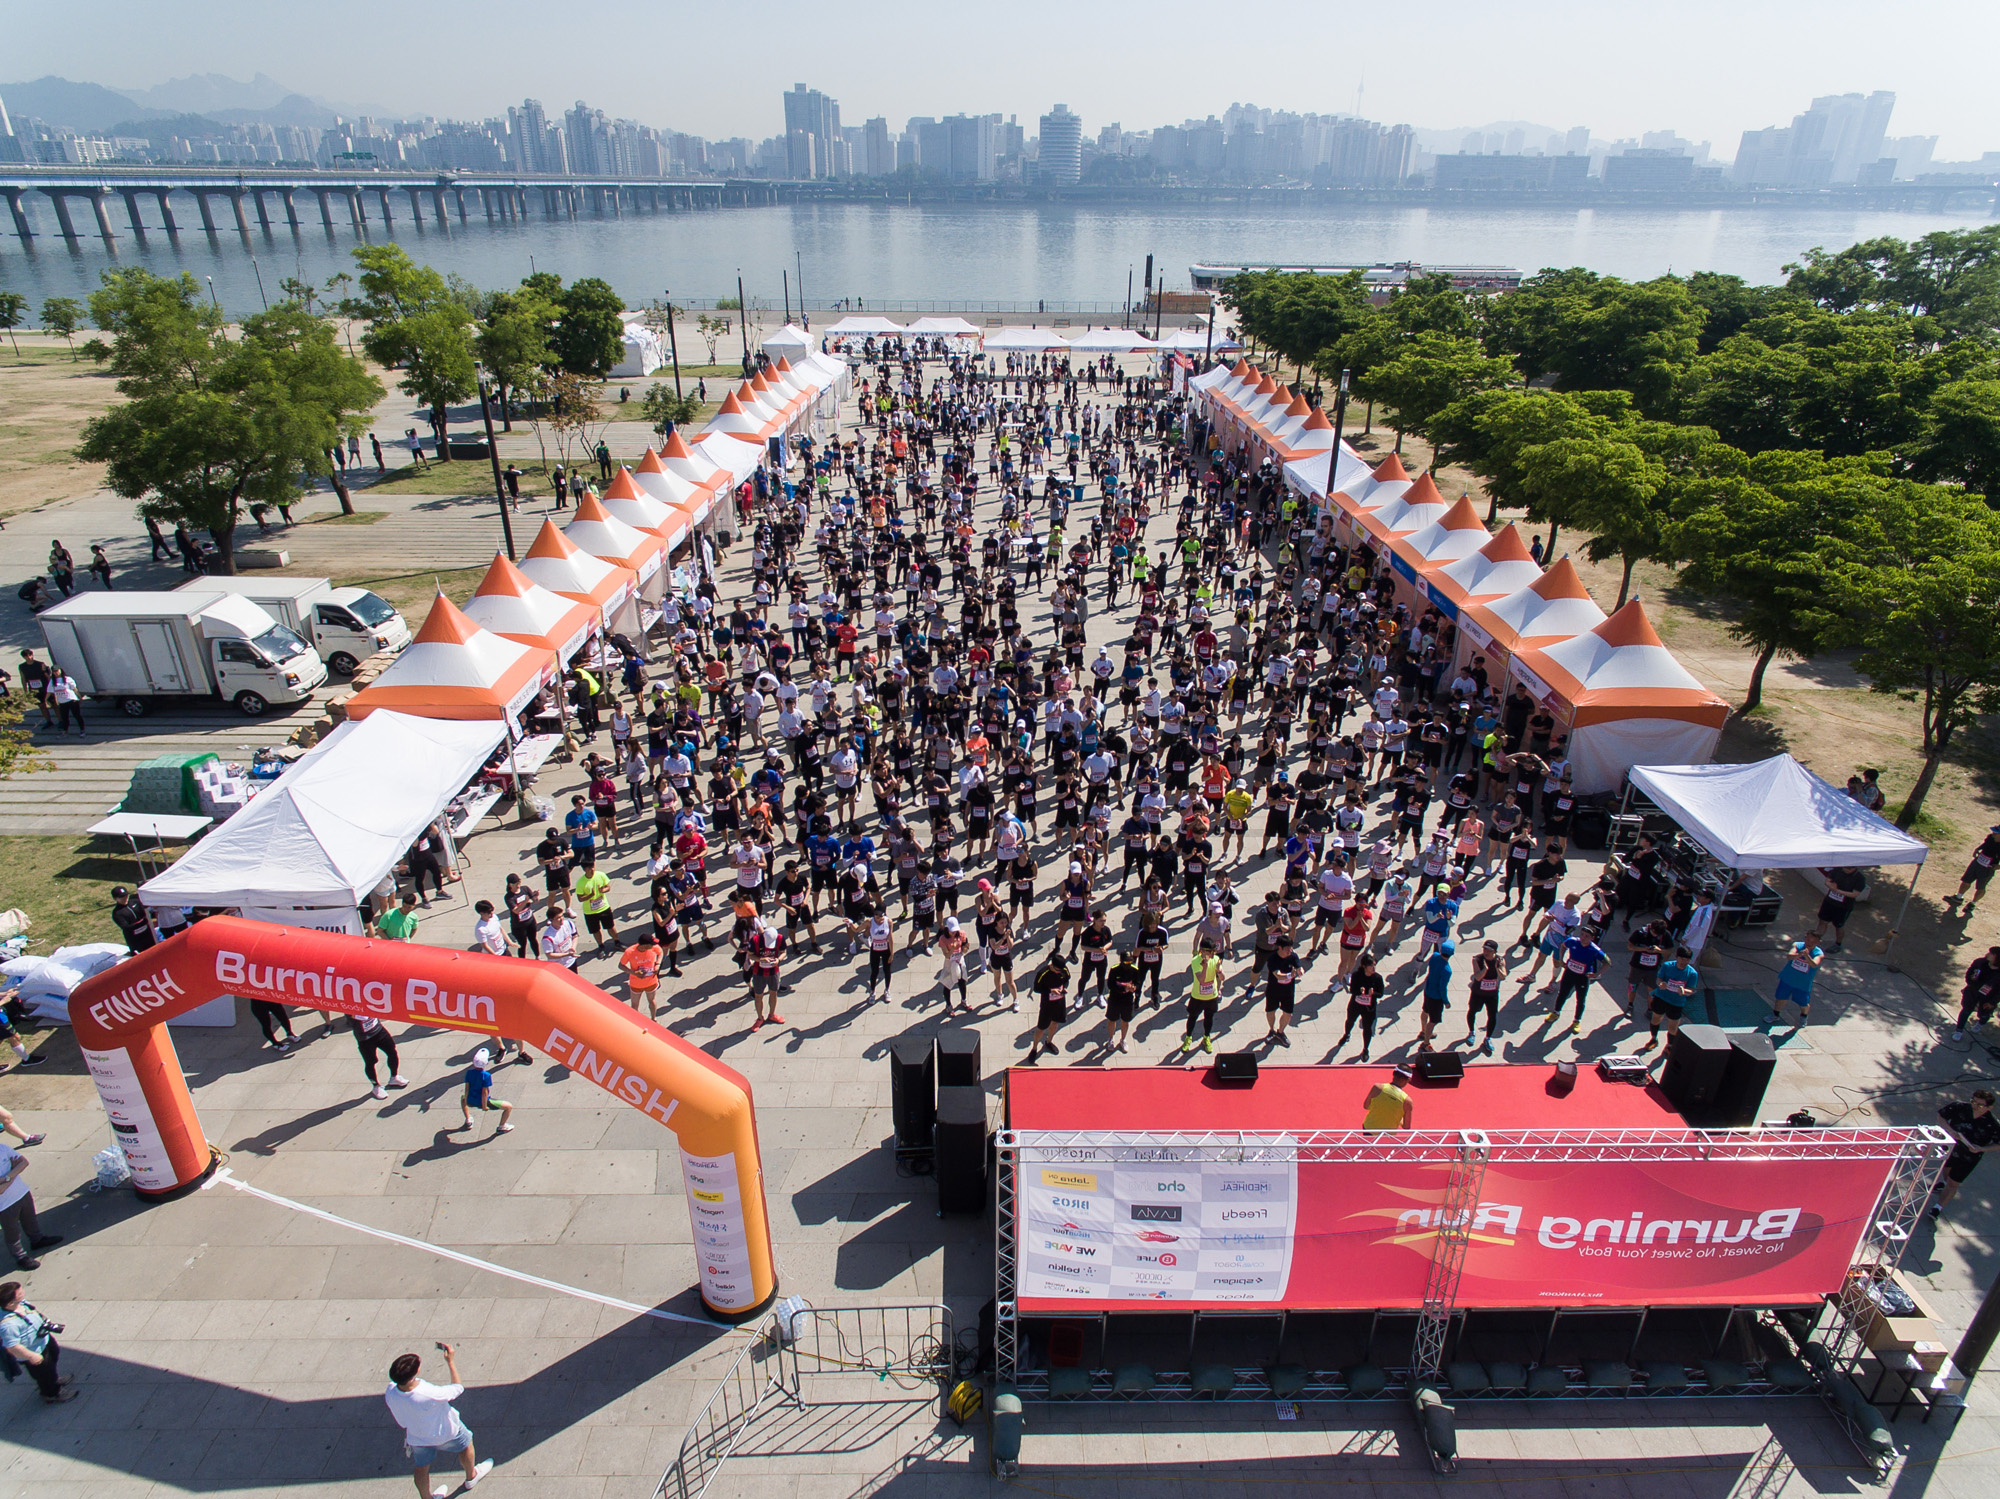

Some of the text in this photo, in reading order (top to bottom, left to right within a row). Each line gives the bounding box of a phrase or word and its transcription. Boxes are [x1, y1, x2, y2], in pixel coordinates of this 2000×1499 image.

[89, 968, 185, 1031] FINISH
[215, 949, 496, 1022] Burning Run
[542, 1027, 680, 1124] FINISH
